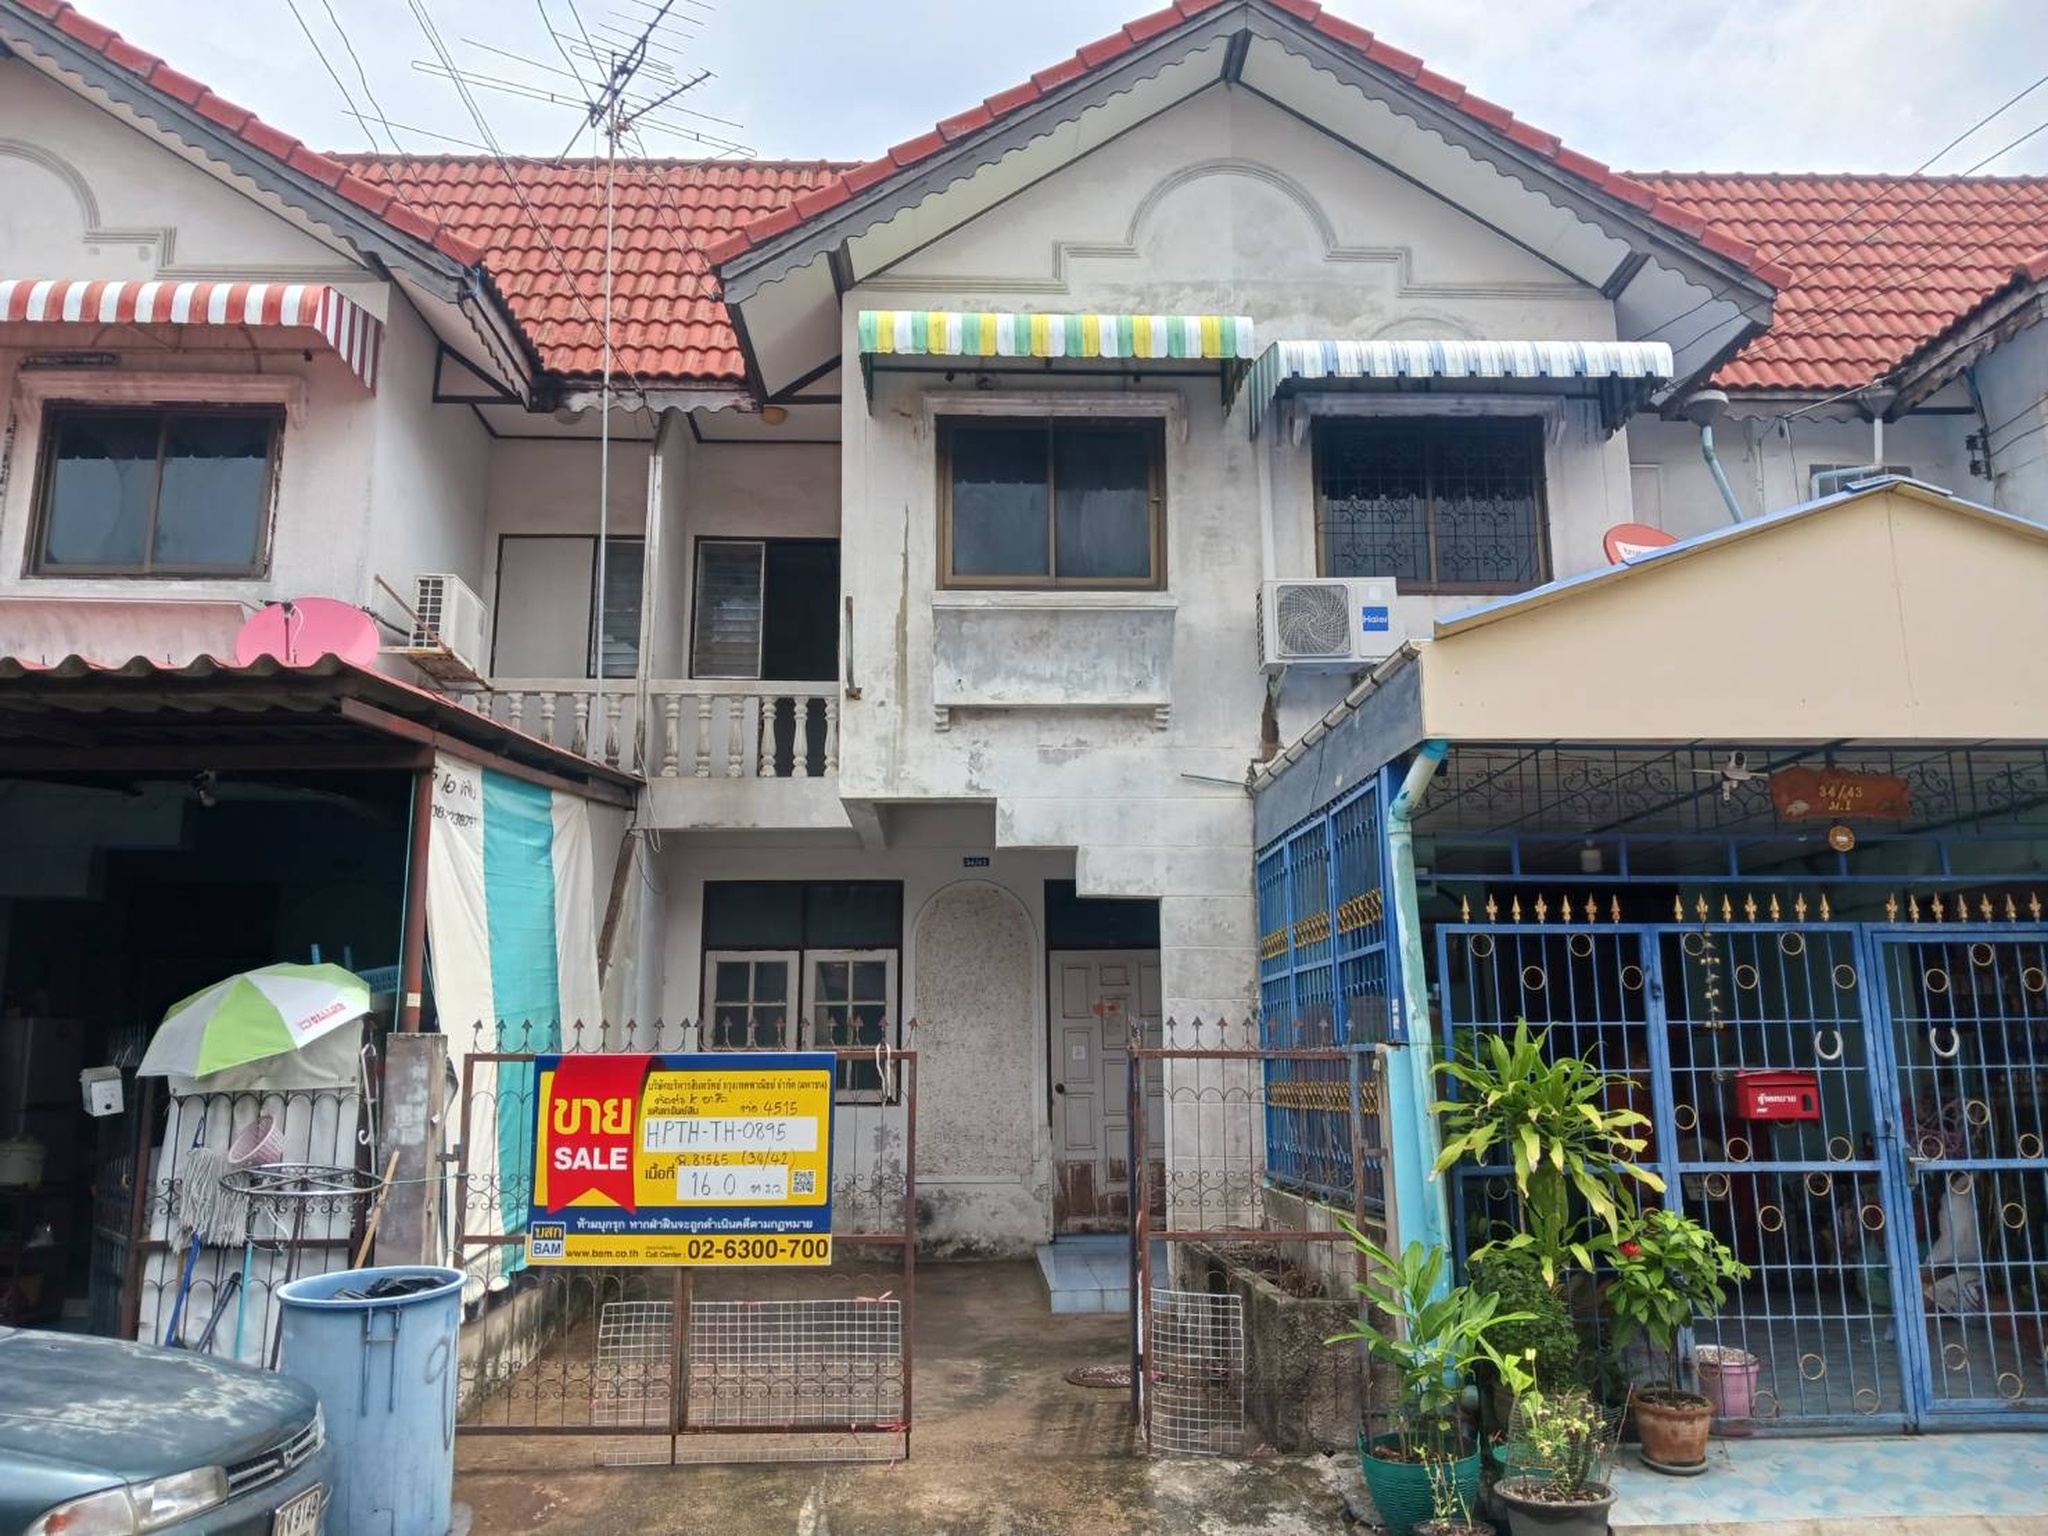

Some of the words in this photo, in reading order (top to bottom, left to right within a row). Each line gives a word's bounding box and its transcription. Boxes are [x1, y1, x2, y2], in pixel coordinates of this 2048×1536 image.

[1819, 783, 1863, 799] 34/43
[554, 1098, 632, 1135] ขาย
[763, 1102, 798, 1116] 4515
[647, 1120, 787, 1148] HPTH-TH-0895
[554, 1146, 628, 1170] SALE
[645, 1162, 675, 1180] เนื้อที่
[576, 1217, 625, 1233] ห้ามบุกรุก
[533, 1242, 561, 1255] BAM
[565, 1249, 639, 1259] www.bam.co.th
[688, 1239, 829, 1259] 02-6300-700
